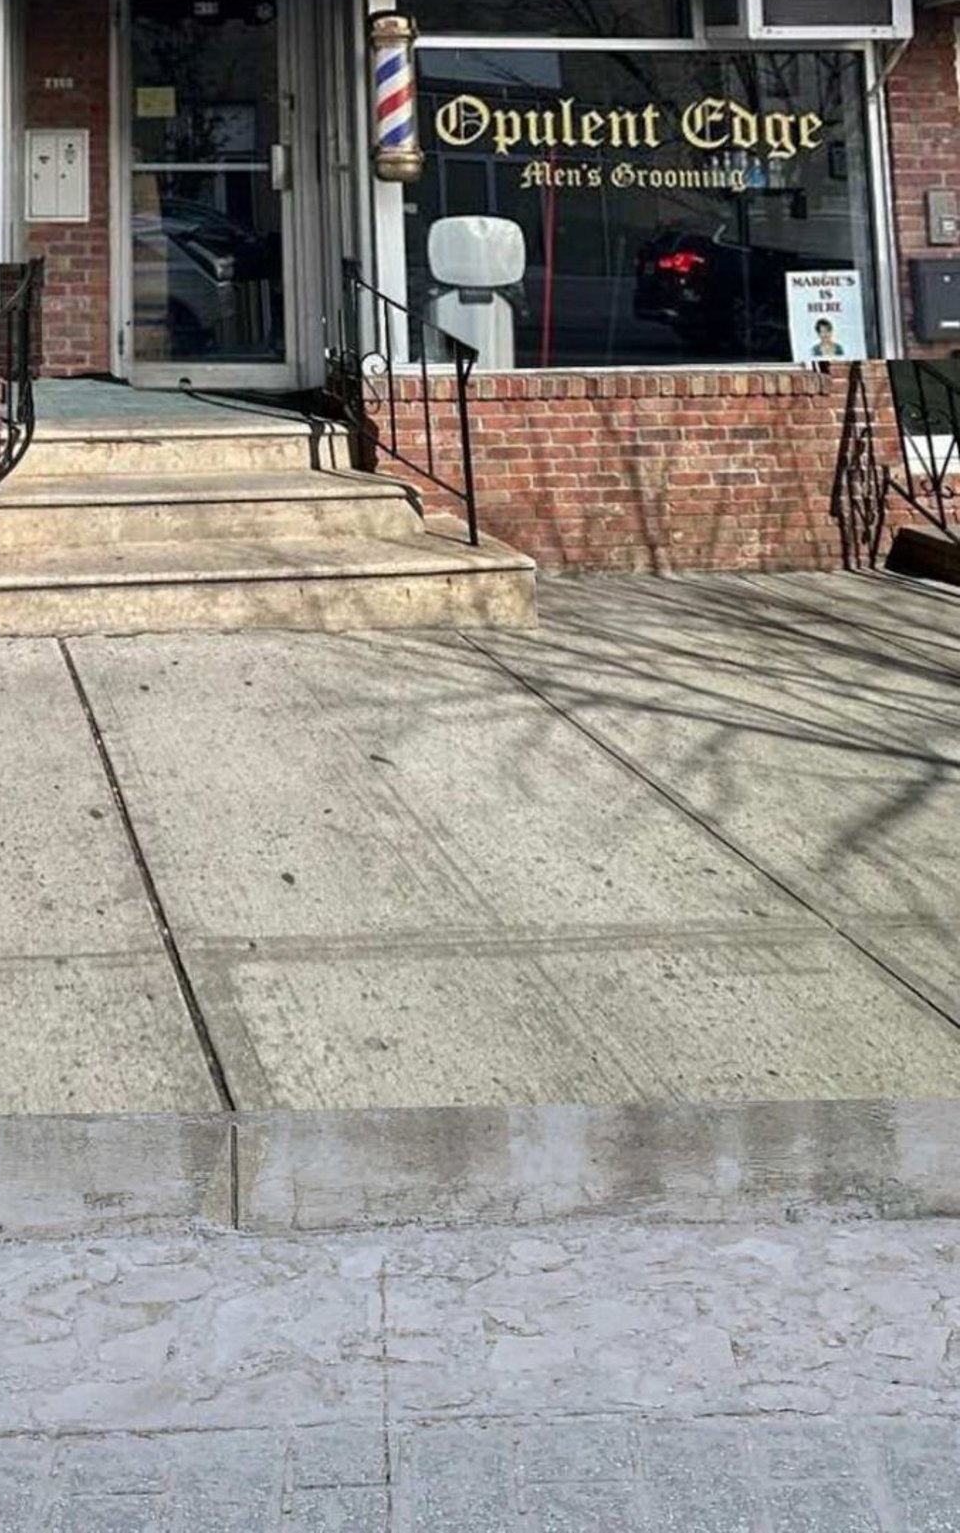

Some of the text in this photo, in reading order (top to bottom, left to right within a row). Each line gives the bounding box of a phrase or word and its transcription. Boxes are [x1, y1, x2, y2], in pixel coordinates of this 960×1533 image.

[436, 94, 823, 159] Opulent Edge
[520, 160, 748, 192] Men's Grooming
